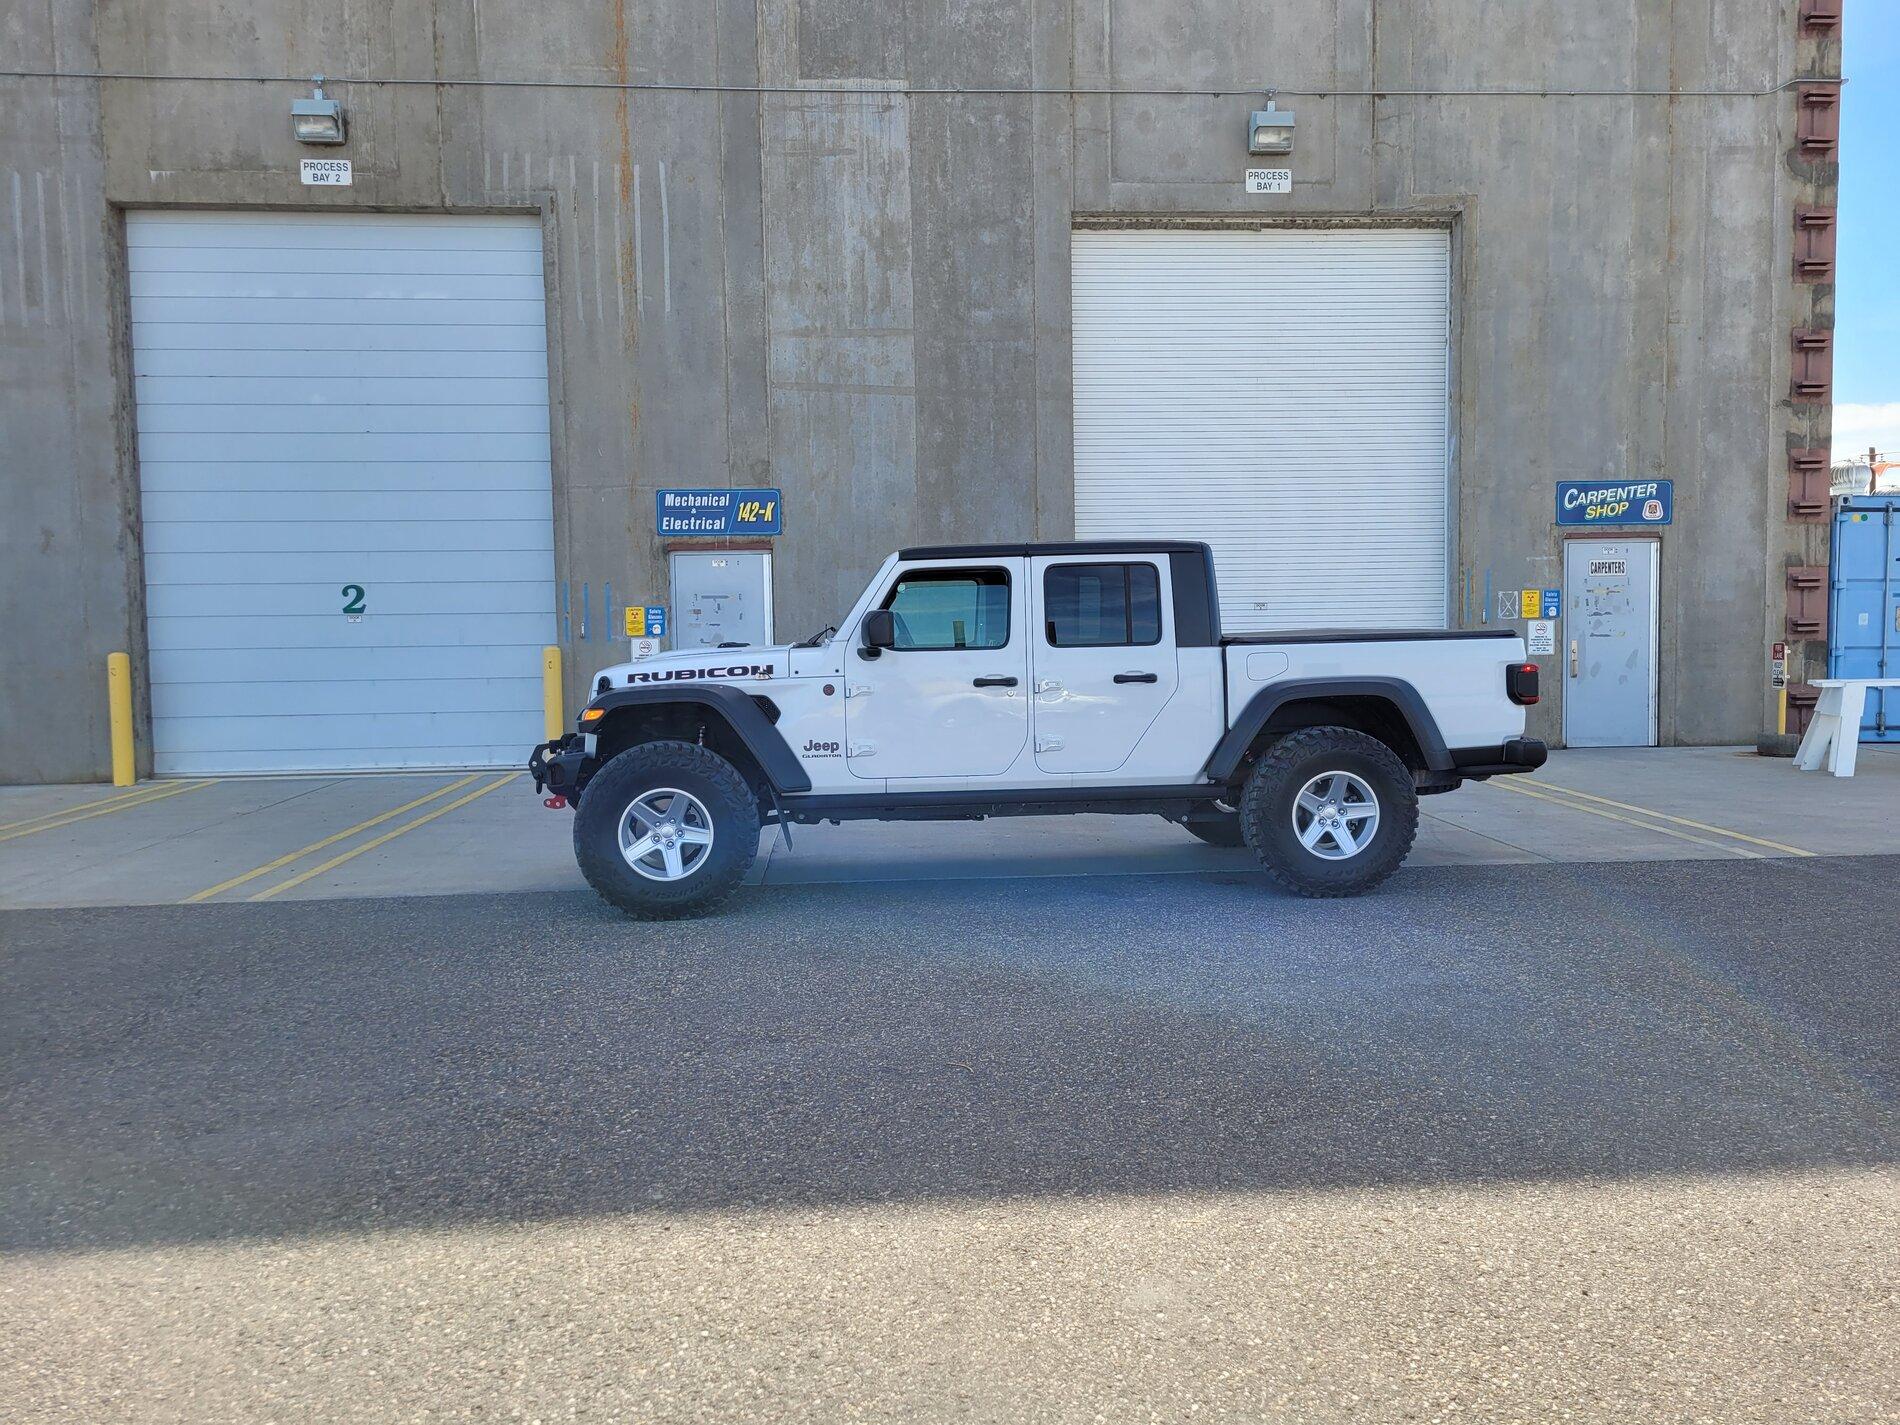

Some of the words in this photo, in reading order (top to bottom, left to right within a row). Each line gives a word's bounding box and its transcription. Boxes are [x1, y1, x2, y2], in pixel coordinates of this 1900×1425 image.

[303, 162, 349, 172] PROCESS
[312, 173, 331, 182] BAY
[335, 173, 341, 182] 2
[1248, 171, 1289, 180] PROCESS
[1256, 182, 1273, 190] BAY
[664, 493, 730, 507] Mechanical
[1564, 483, 1658, 509] CARPENTER
[737, 501, 775, 522] 142-K
[1585, 502, 1629, 519] SHOP
[662, 516, 726, 530] Electrical
[1590, 561, 1626, 574] CARPENTERS
[341, 584, 368, 614] 2
[627, 664, 774, 684] RUBICON
[803, 739, 840, 753] Jeep
